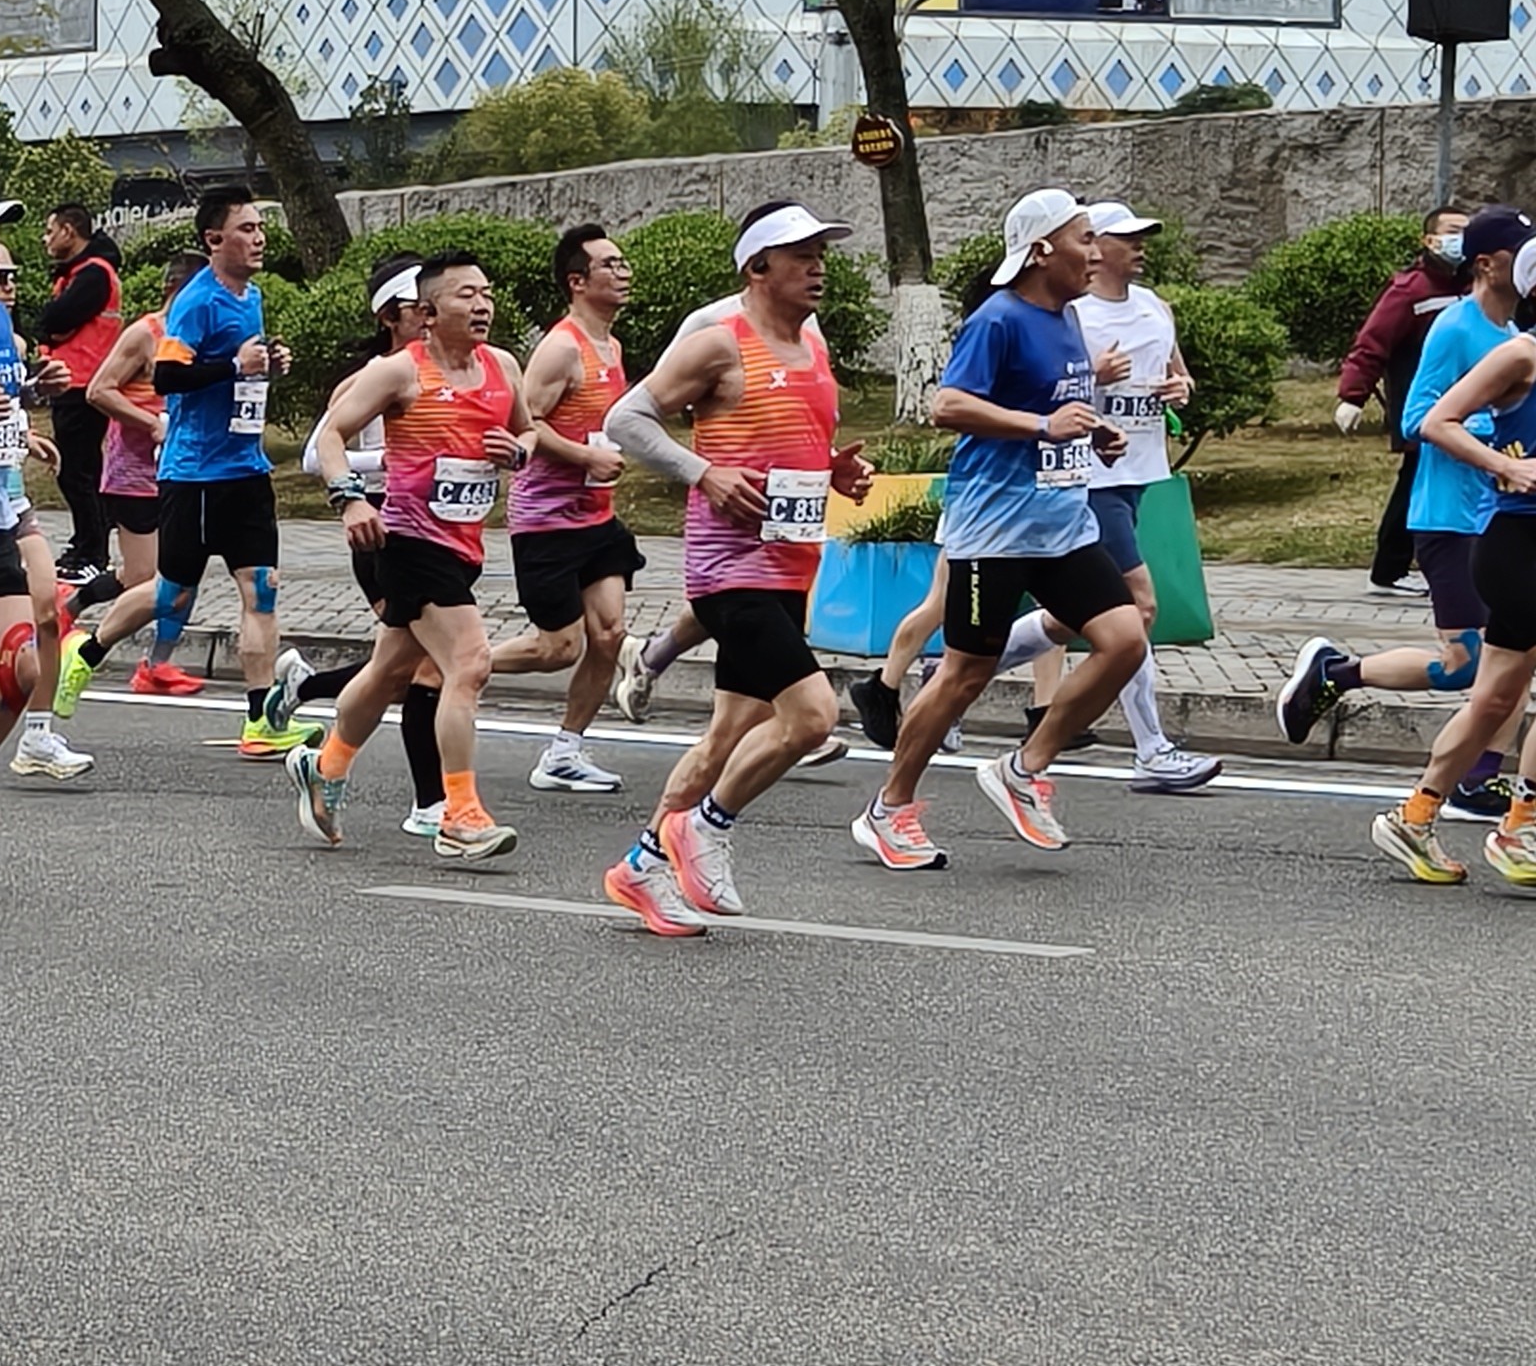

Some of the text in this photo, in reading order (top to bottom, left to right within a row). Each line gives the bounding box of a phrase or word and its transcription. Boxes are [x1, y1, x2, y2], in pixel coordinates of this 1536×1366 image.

[1111, 396, 1125, 416] D
[1041, 449, 1056, 470] D
[437, 482, 455, 502] C
[770, 497, 788, 521] C
